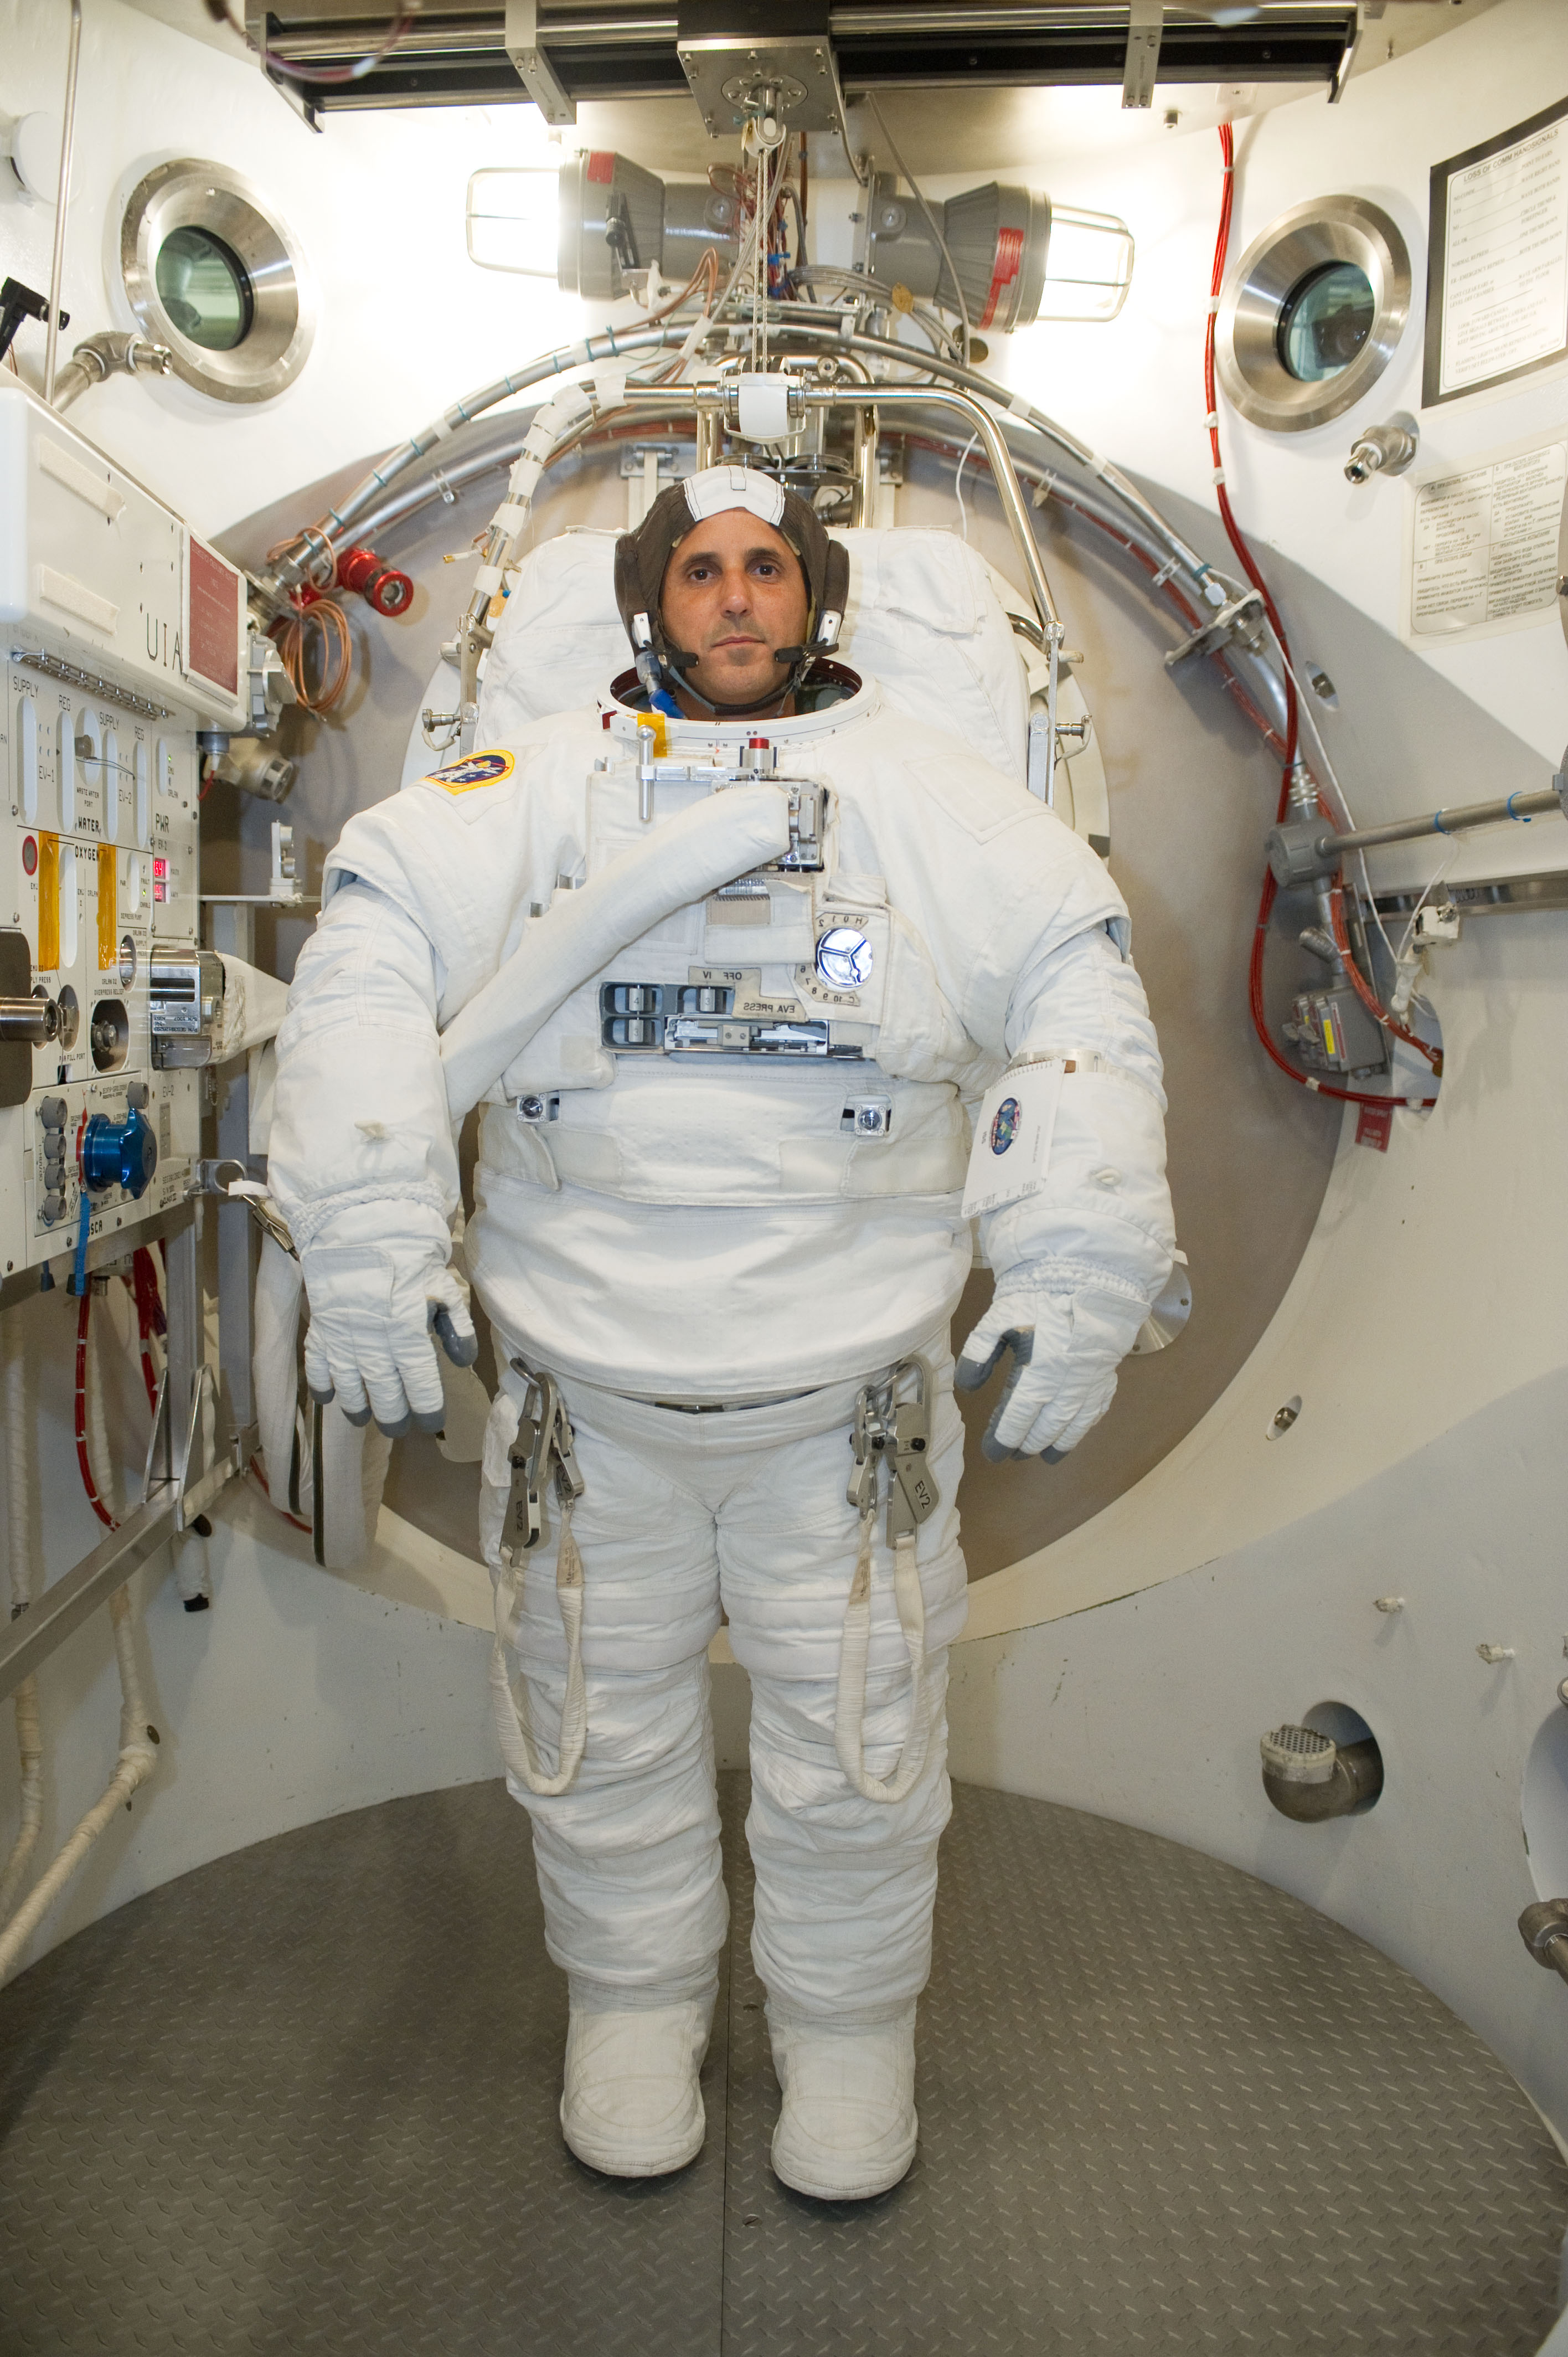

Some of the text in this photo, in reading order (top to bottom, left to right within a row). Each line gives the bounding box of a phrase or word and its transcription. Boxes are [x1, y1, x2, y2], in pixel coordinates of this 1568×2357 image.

[1463, 127, 1559, 183] LOSS OF COMM HANDSIGNALS
[146, 613, 183, 676] UIA
[13, 676, 39, 698] SUPPLY
[59, 694, 71, 711] REG
[99, 712, 119, 730] SUPPLY
[135, 726, 145, 740] REG
[39, 765, 54, 783] EV-1
[76, 786, 100, 799] WASTE WATER
[118, 789, 132, 805] EV-2
[84, 799, 93, 807] PORT
[78, 816, 100, 832] WATER
[156, 813, 169, 833] PWR
[75, 845, 100, 862] OXYGEN
[162, 1085, 174, 1098] EV-2
[556, 1465, 572, 1494] EV2
[915, 1480, 931, 1510] EV2
